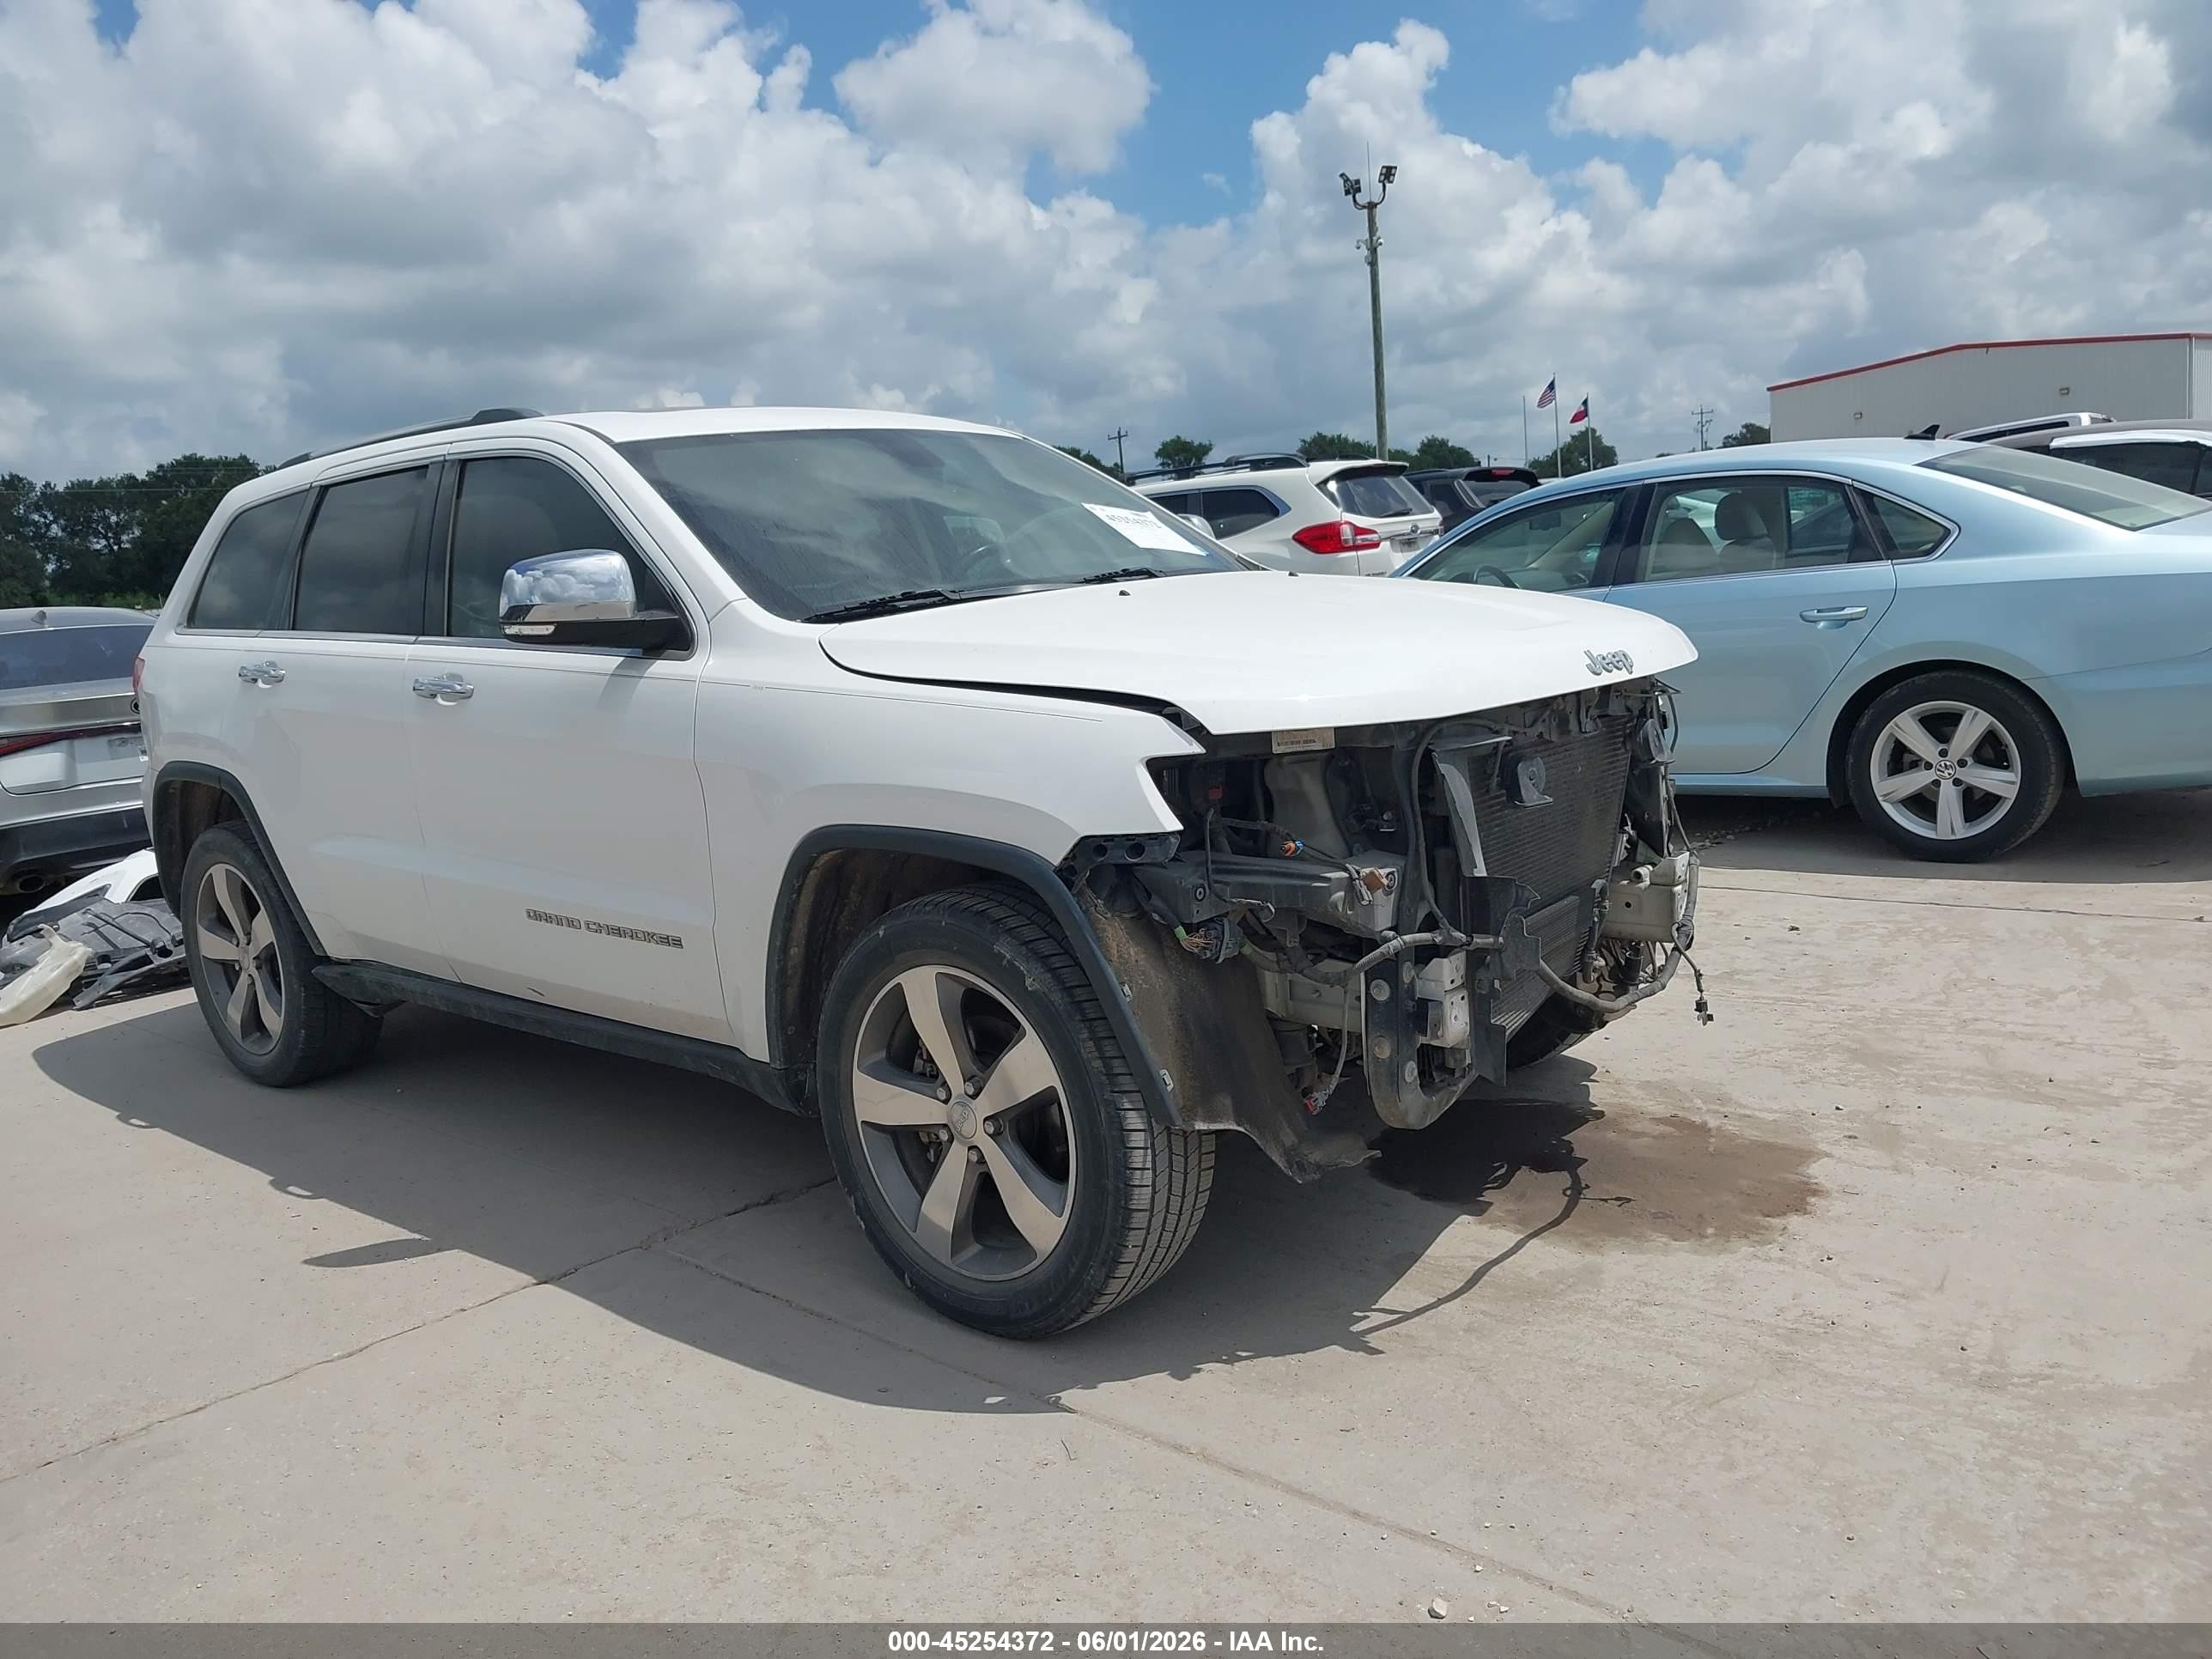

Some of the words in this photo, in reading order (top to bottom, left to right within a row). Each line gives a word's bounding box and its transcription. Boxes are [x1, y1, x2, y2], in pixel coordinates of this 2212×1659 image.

[1583, 649, 1634, 676] Jeep
[526, 908, 582, 930] GRAND
[584, 920, 684, 949] CHEROKEE
